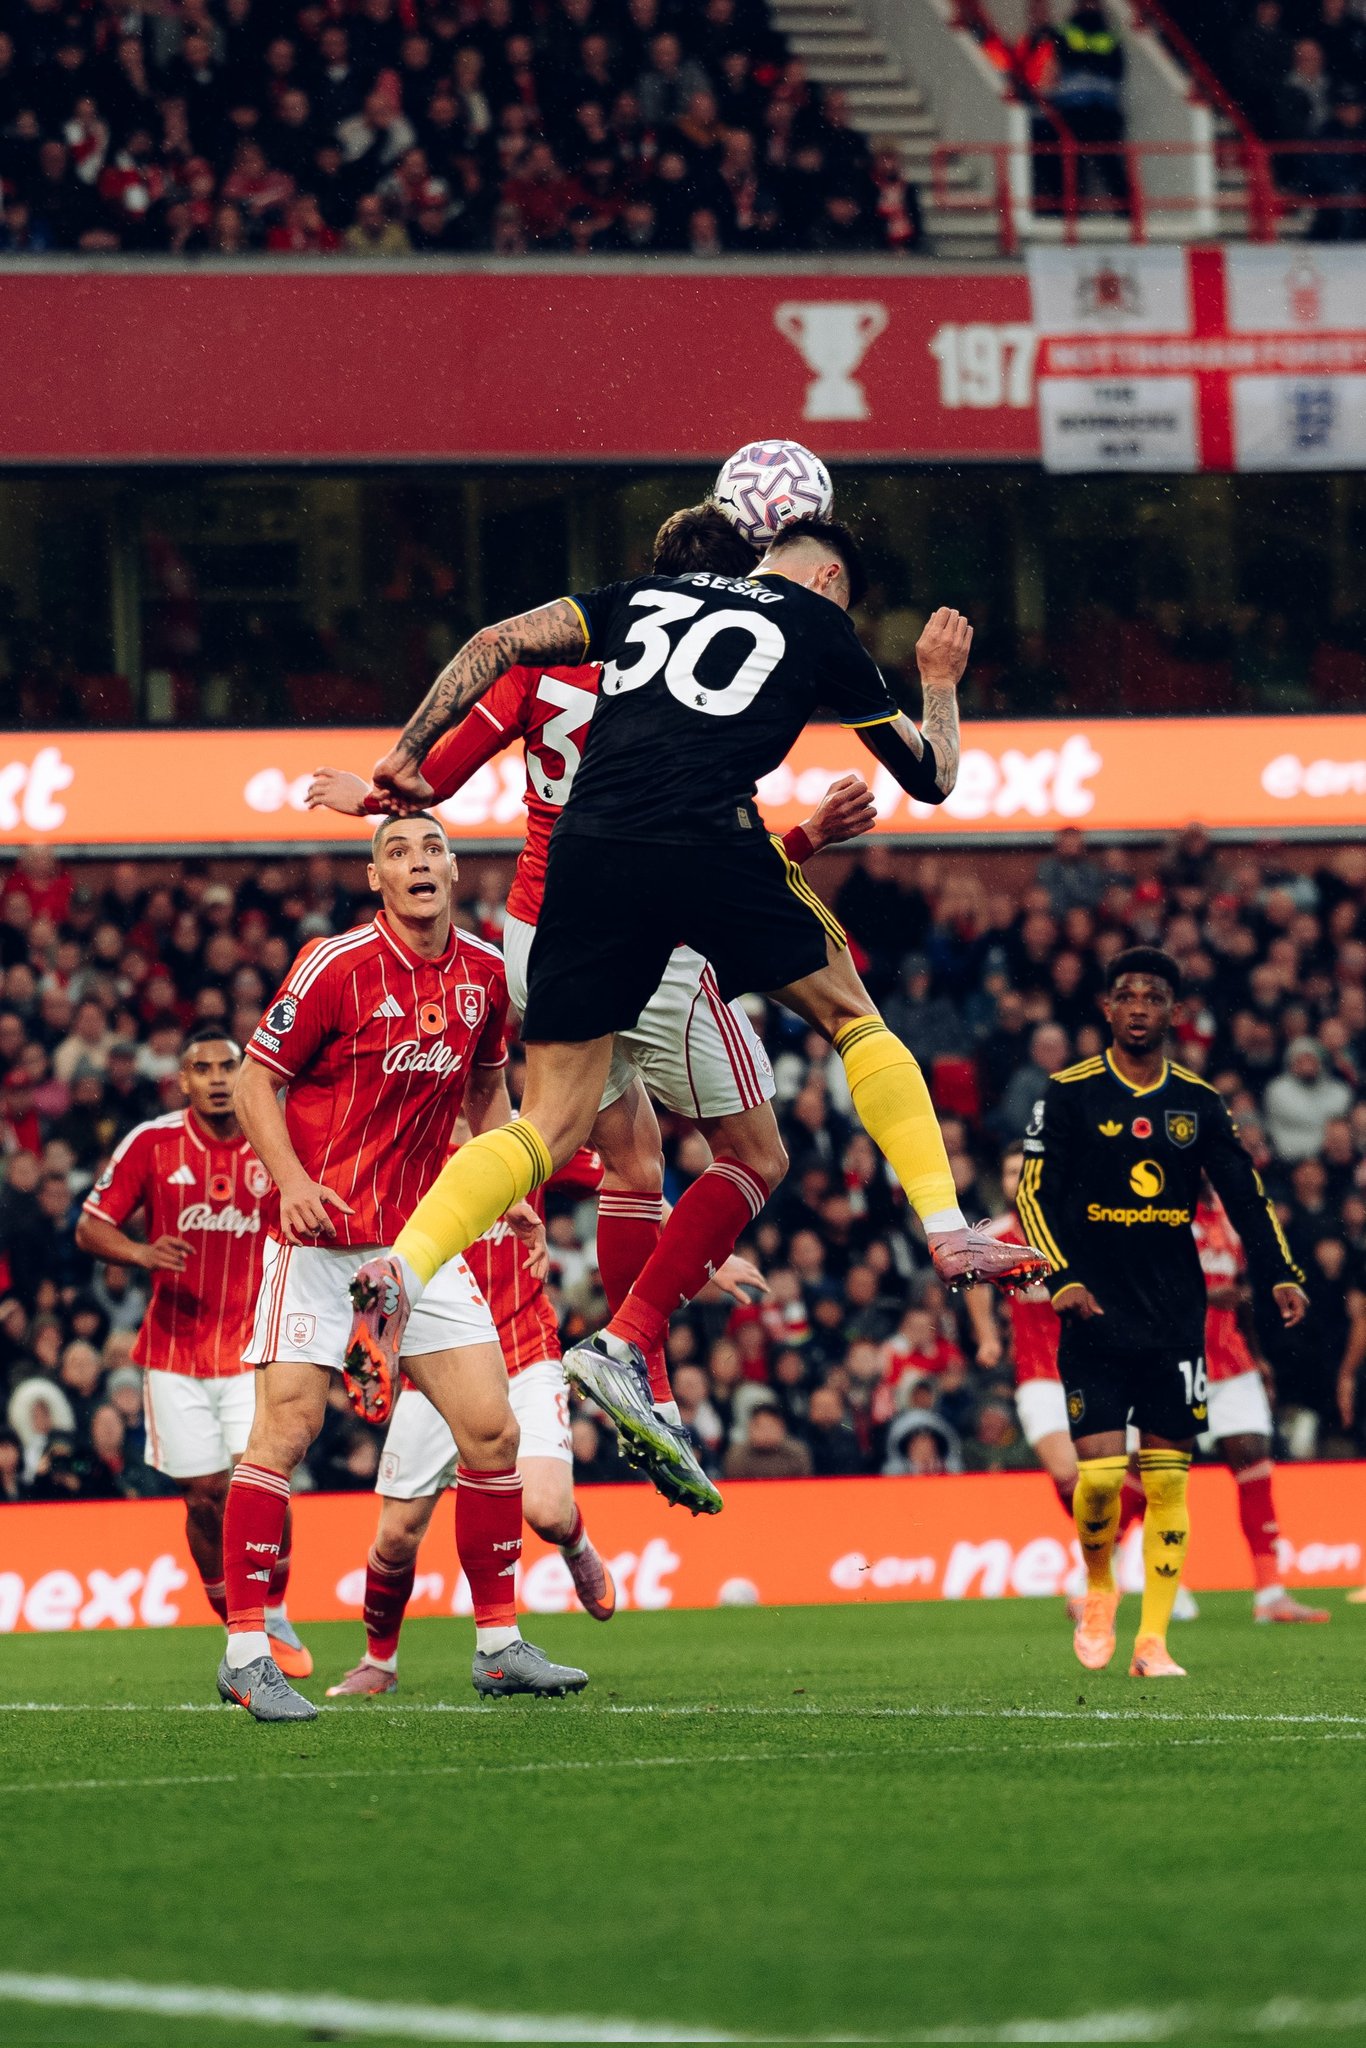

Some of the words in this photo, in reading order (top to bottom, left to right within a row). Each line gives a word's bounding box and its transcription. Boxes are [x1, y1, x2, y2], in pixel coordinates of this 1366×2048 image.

[929, 323, 1034, 408] 197
[602, 589, 786, 717] 30
[382, 1040, 463, 1080] Bally
[177, 1203, 261, 1239] Bally's
[1087, 1203, 1191, 1227] Snapdrago
[1178, 1357, 1207, 1405] 16
